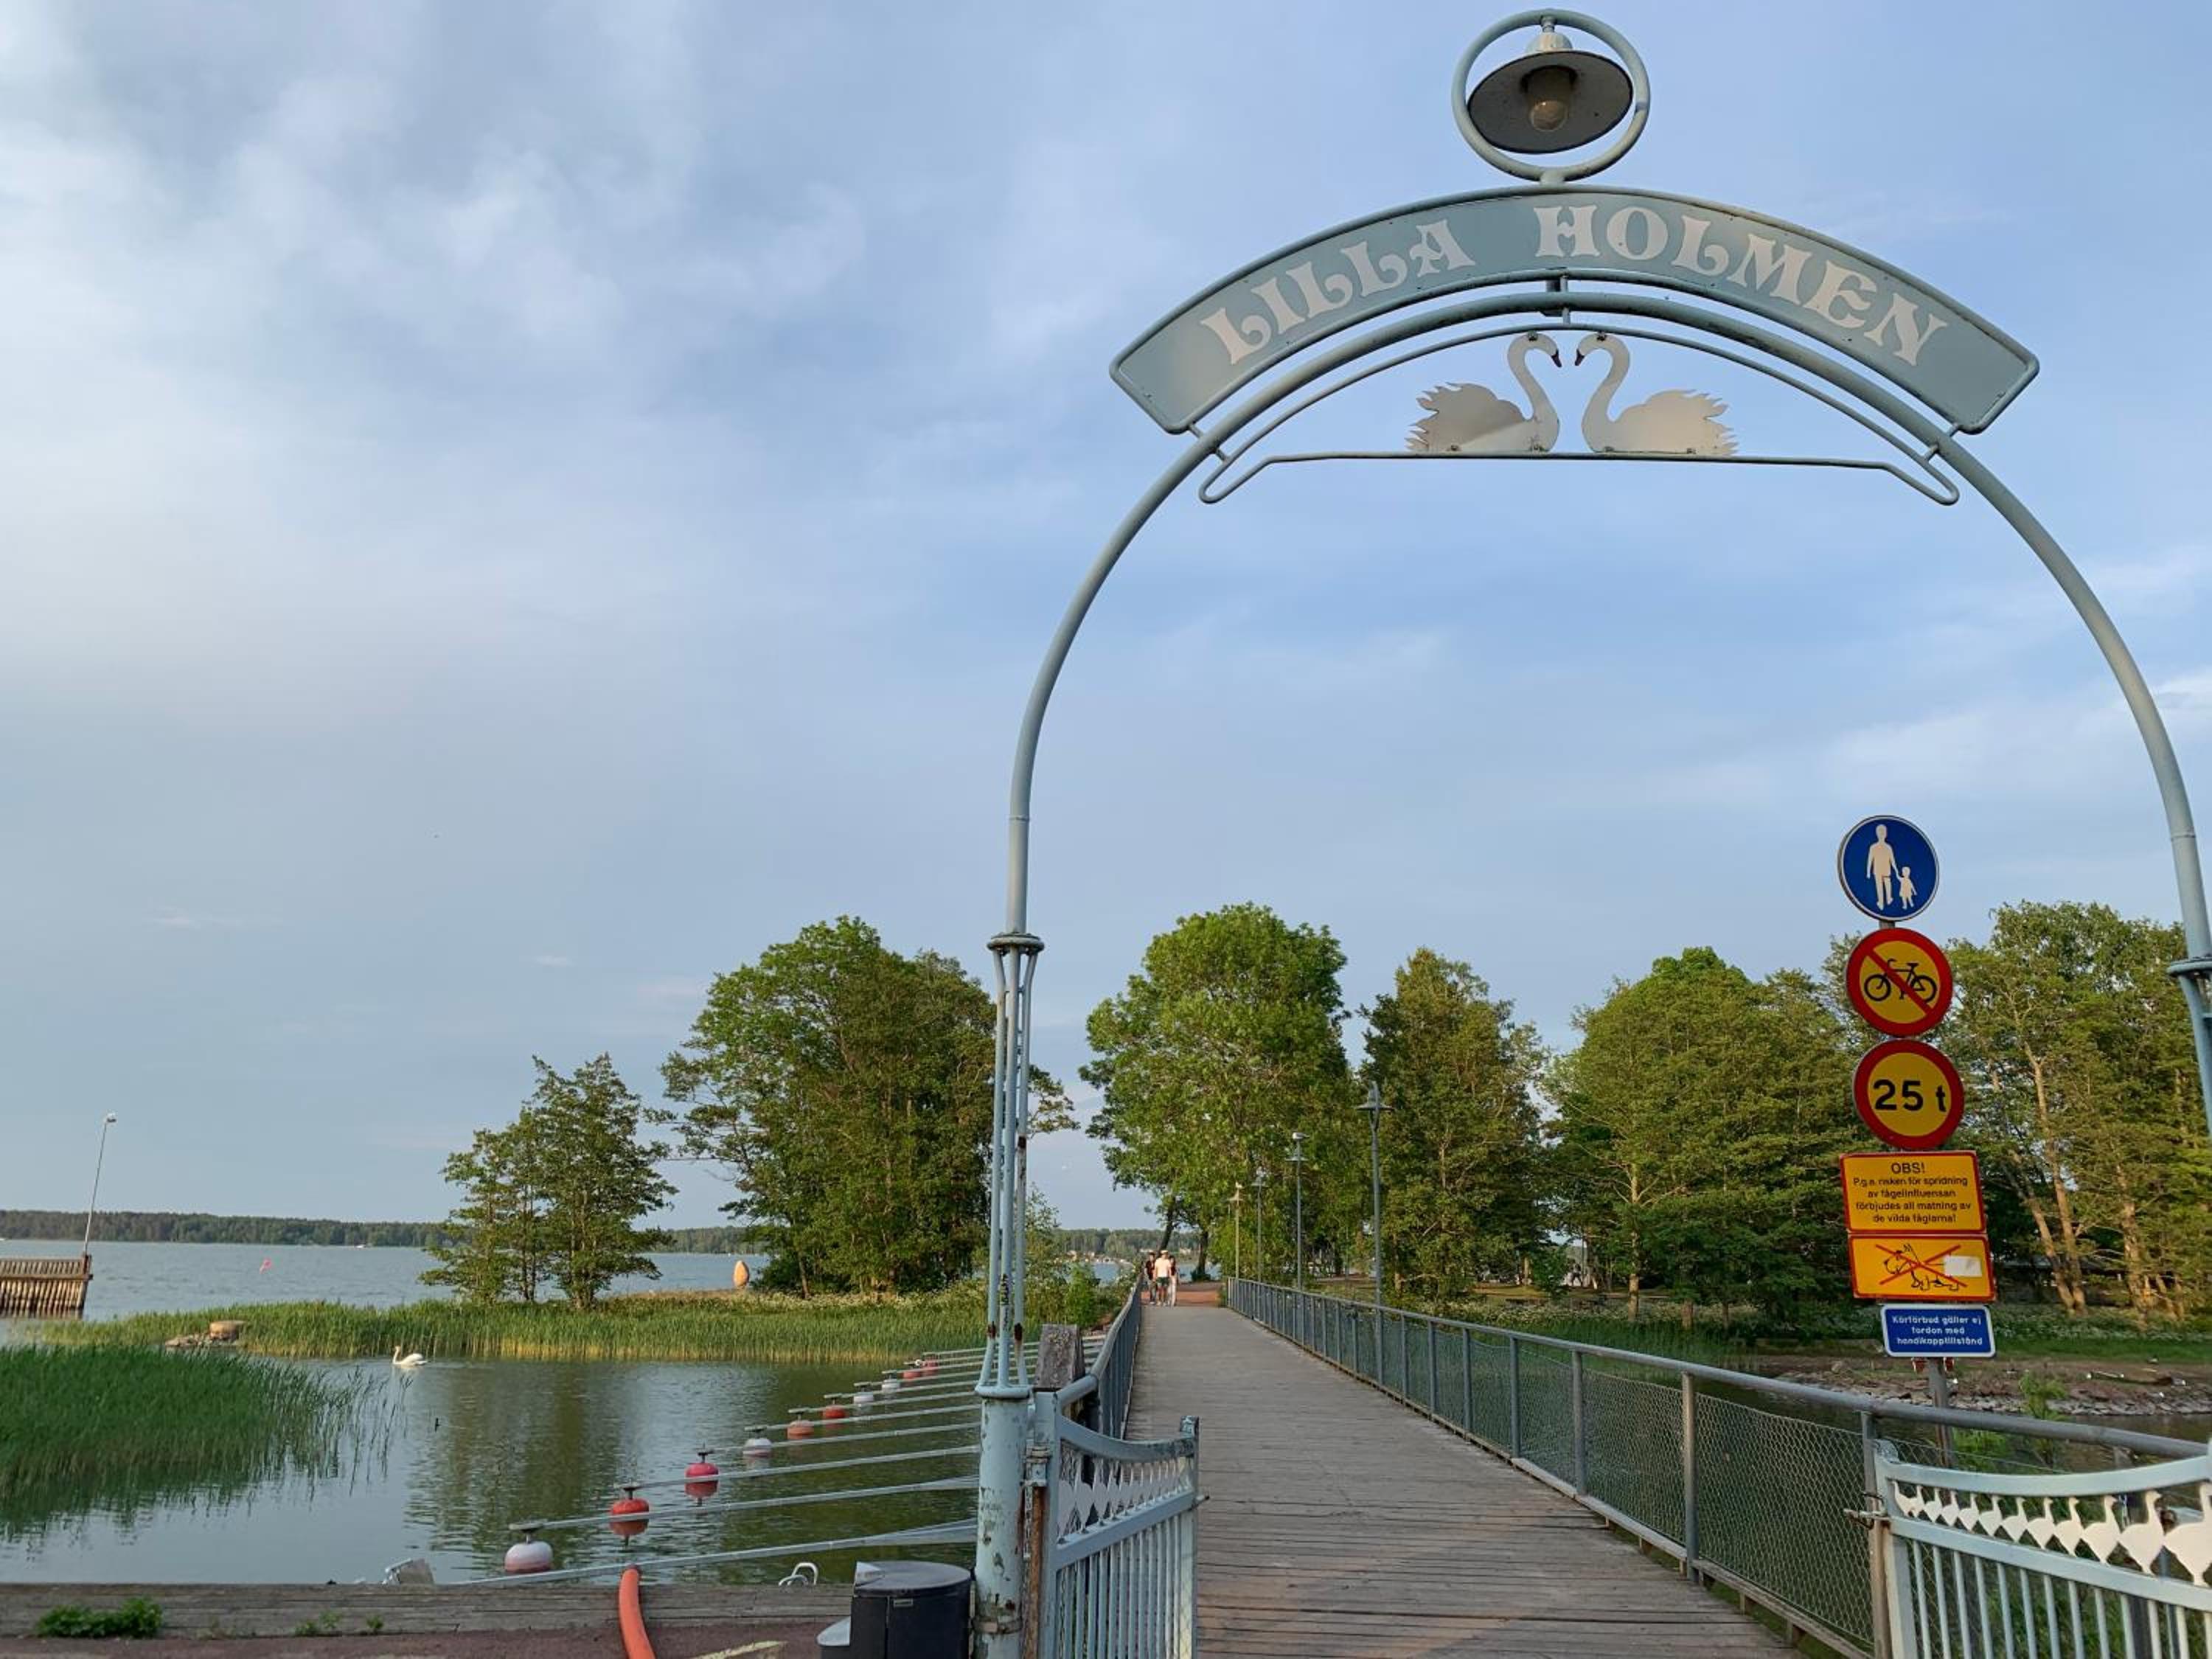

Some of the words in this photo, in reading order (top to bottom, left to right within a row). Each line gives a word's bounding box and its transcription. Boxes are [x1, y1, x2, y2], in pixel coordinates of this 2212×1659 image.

[1199, 219, 1475, 366] LILLA
[1533, 205, 1947, 366] HOLMEN
[1872, 1079, 1924, 1111] 25
[1935, 1085, 1947, 1113] t
[1891, 1162, 1925, 1175] OBS!
[1878, 1178, 1906, 1186] risken
[1908, 1176, 1921, 1186] för
[1923, 1176, 1968, 1187] spridning
[1881, 1189, 1956, 1200] fågelinfluensan
[1856, 1201, 1901, 1212] förbjudes
[1903, 1202, 1915, 1210] all
[1917, 1201, 1958, 1211] matning
[1941, 1316, 1969, 1326] gäller
[1972, 1316, 1981, 1326] ej
[1911, 1326, 1943, 1335] fordon
